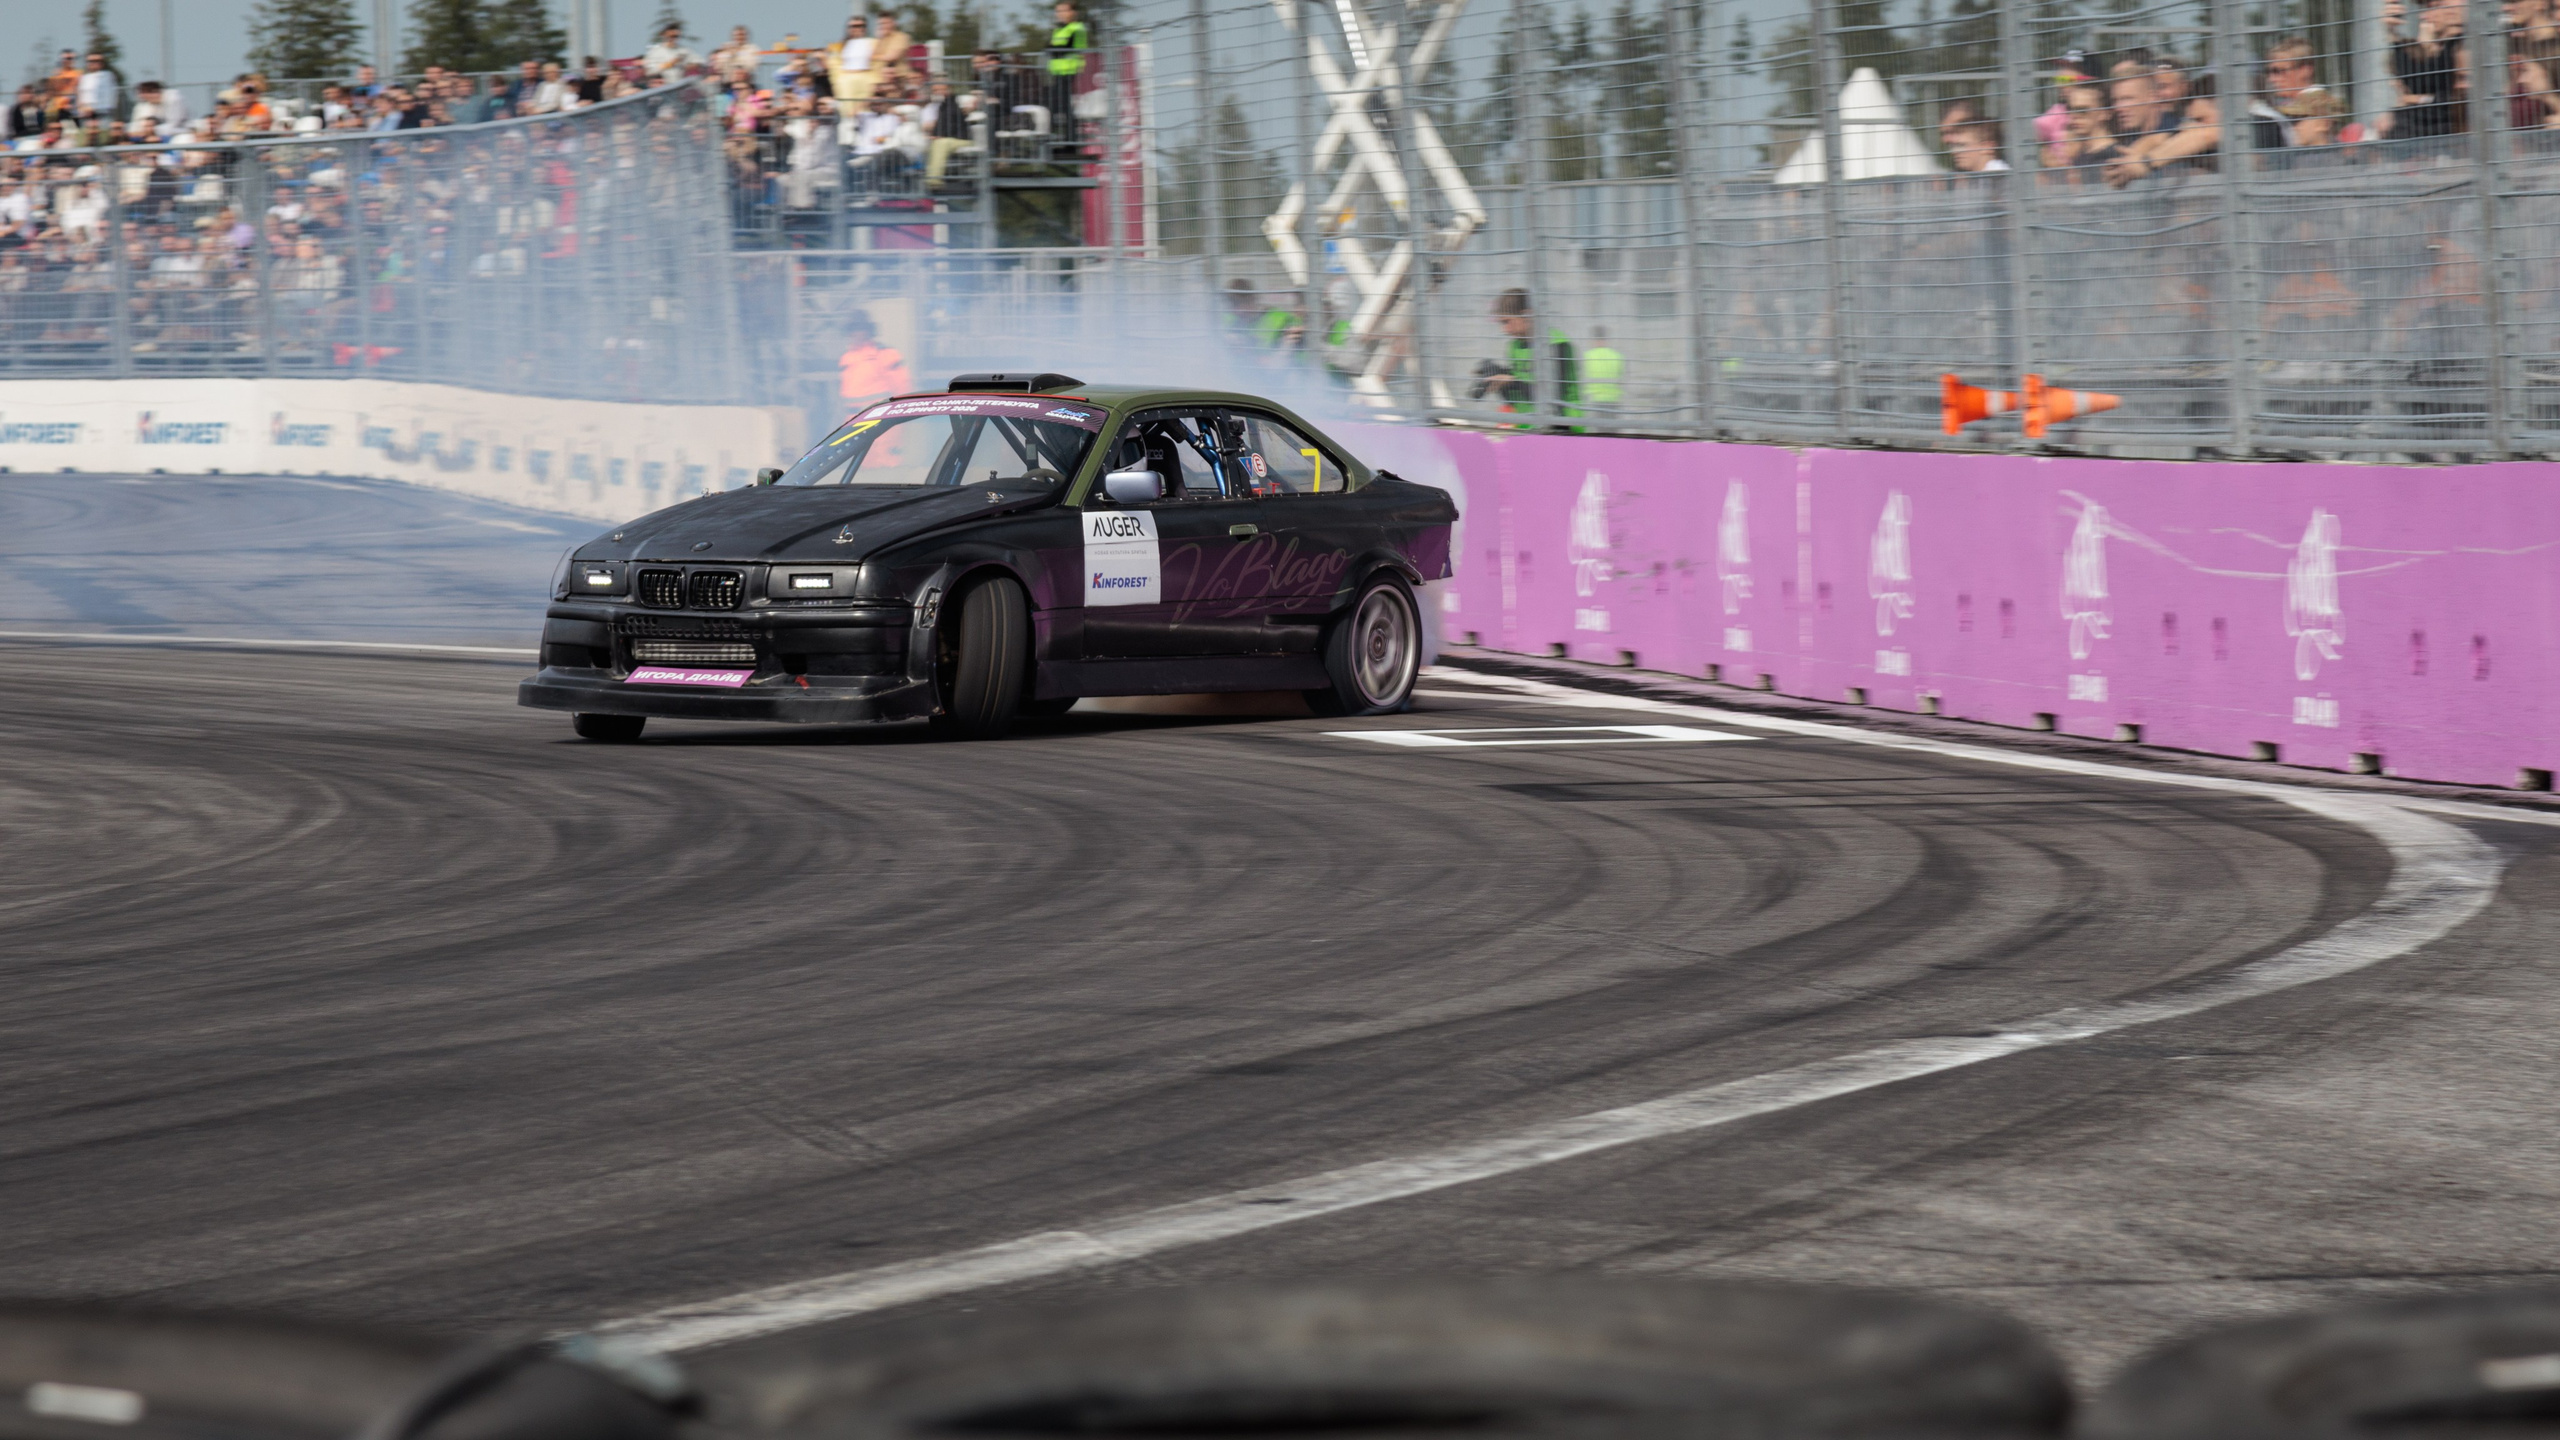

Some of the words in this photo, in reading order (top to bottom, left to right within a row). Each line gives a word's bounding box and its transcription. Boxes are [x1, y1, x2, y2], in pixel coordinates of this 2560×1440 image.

[894, 401, 932, 409] КУБОК
[828, 419, 882, 447] 7
[1301, 448, 1321, 493] 7
[1093, 516, 1145, 538] AUGER
[1092, 572, 1148, 589] KINFOREST
[634, 671, 685, 680] ИГОРА
[685, 672, 743, 682] ДРАЙВ
